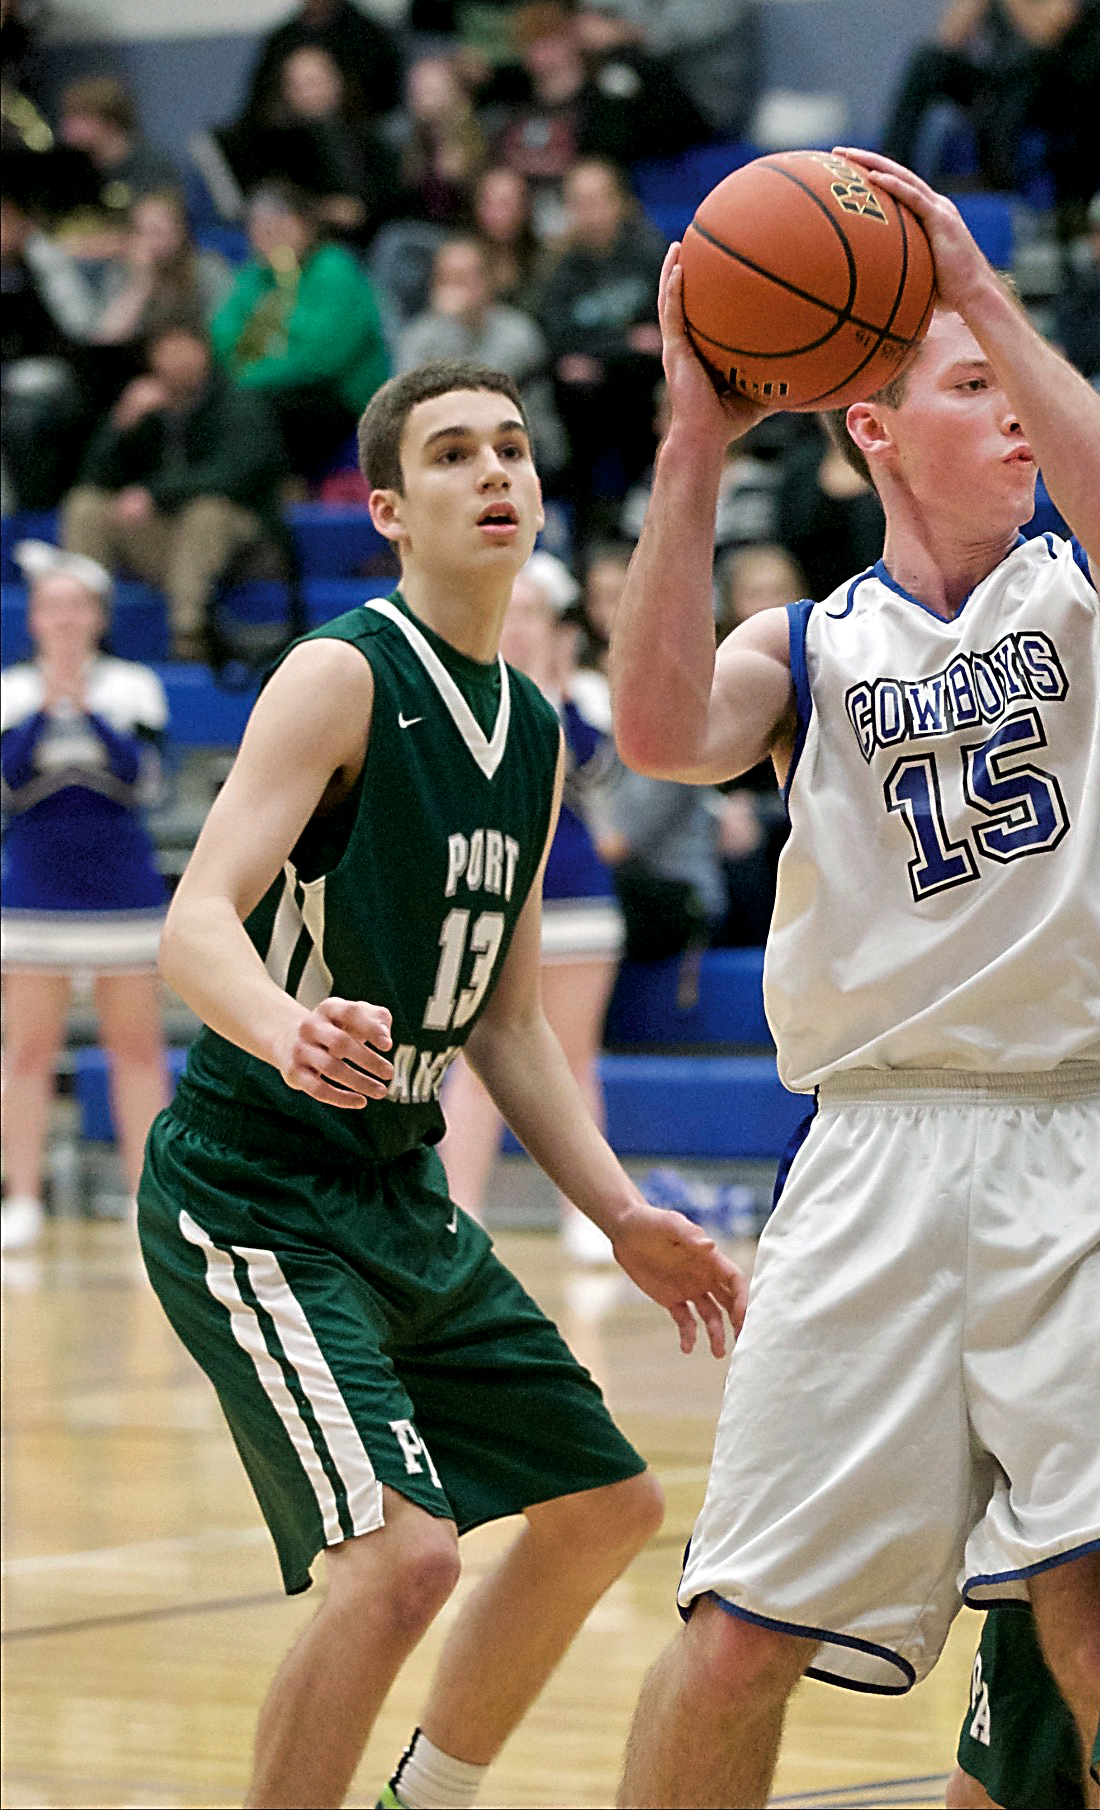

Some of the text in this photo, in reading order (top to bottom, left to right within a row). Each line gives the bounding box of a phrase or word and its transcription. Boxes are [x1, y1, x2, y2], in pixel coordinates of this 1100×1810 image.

[845, 631, 1069, 765] COWBOYS
[445, 829, 520, 902] PORT
[883, 707, 1070, 902] 15
[422, 908, 505, 1030] 13
